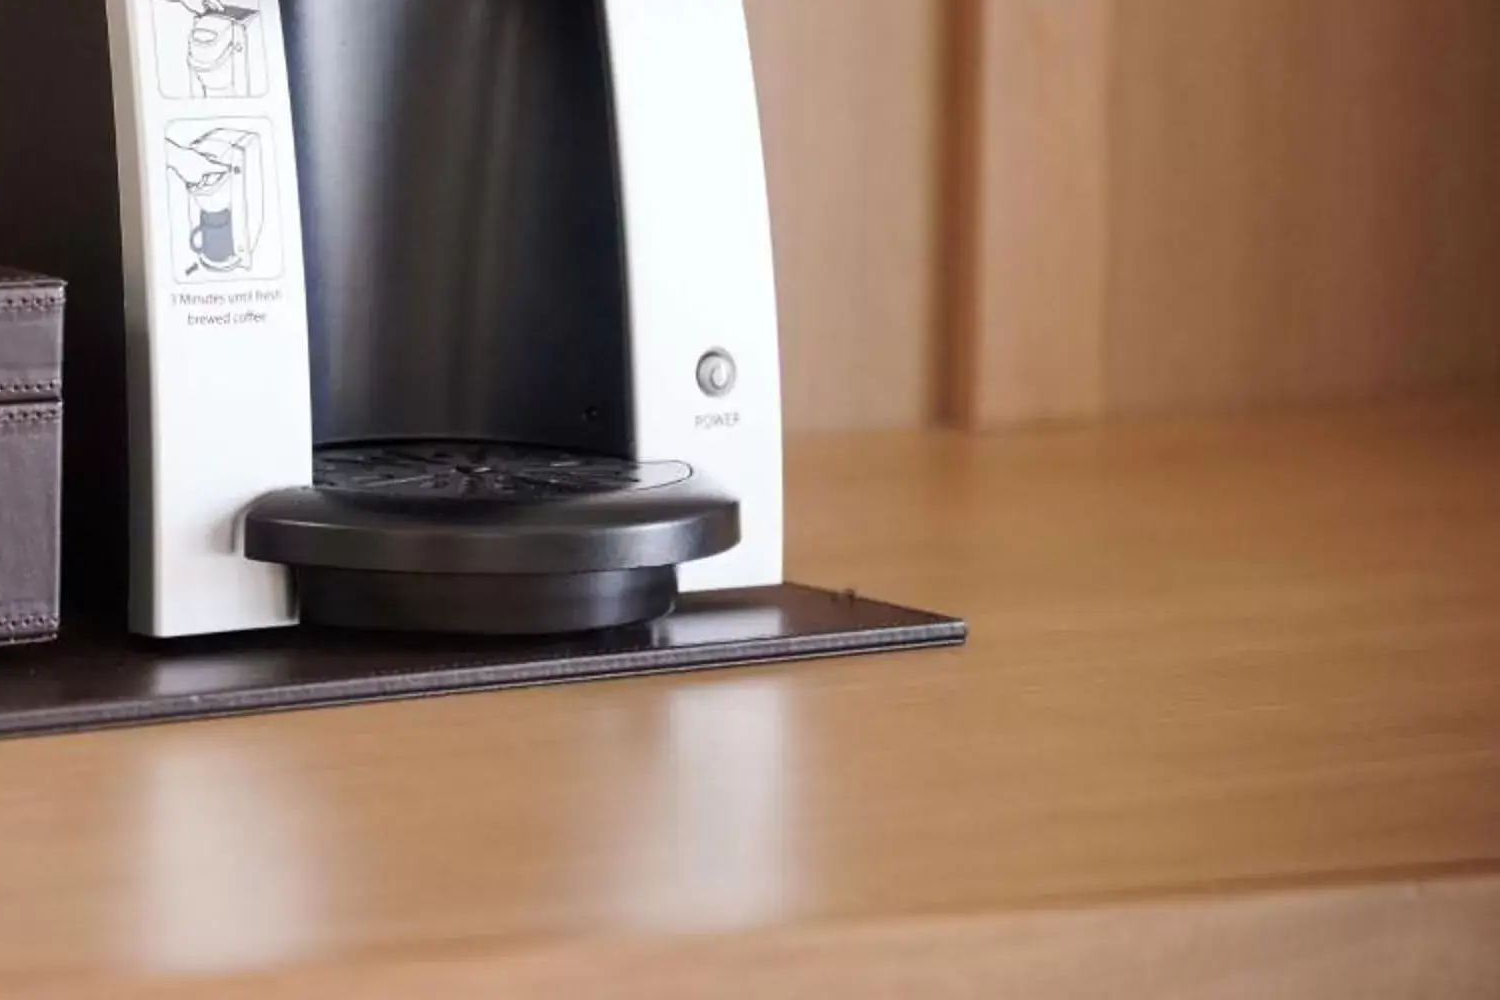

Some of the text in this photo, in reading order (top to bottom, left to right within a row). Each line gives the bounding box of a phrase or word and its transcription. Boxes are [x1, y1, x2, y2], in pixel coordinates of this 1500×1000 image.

[179, 292, 225, 306] Minutes
[228, 290, 253, 304] until
[255, 288, 283, 302] fresh
[187, 309, 268, 326] brewed coffee
[694, 411, 741, 429] POWER
